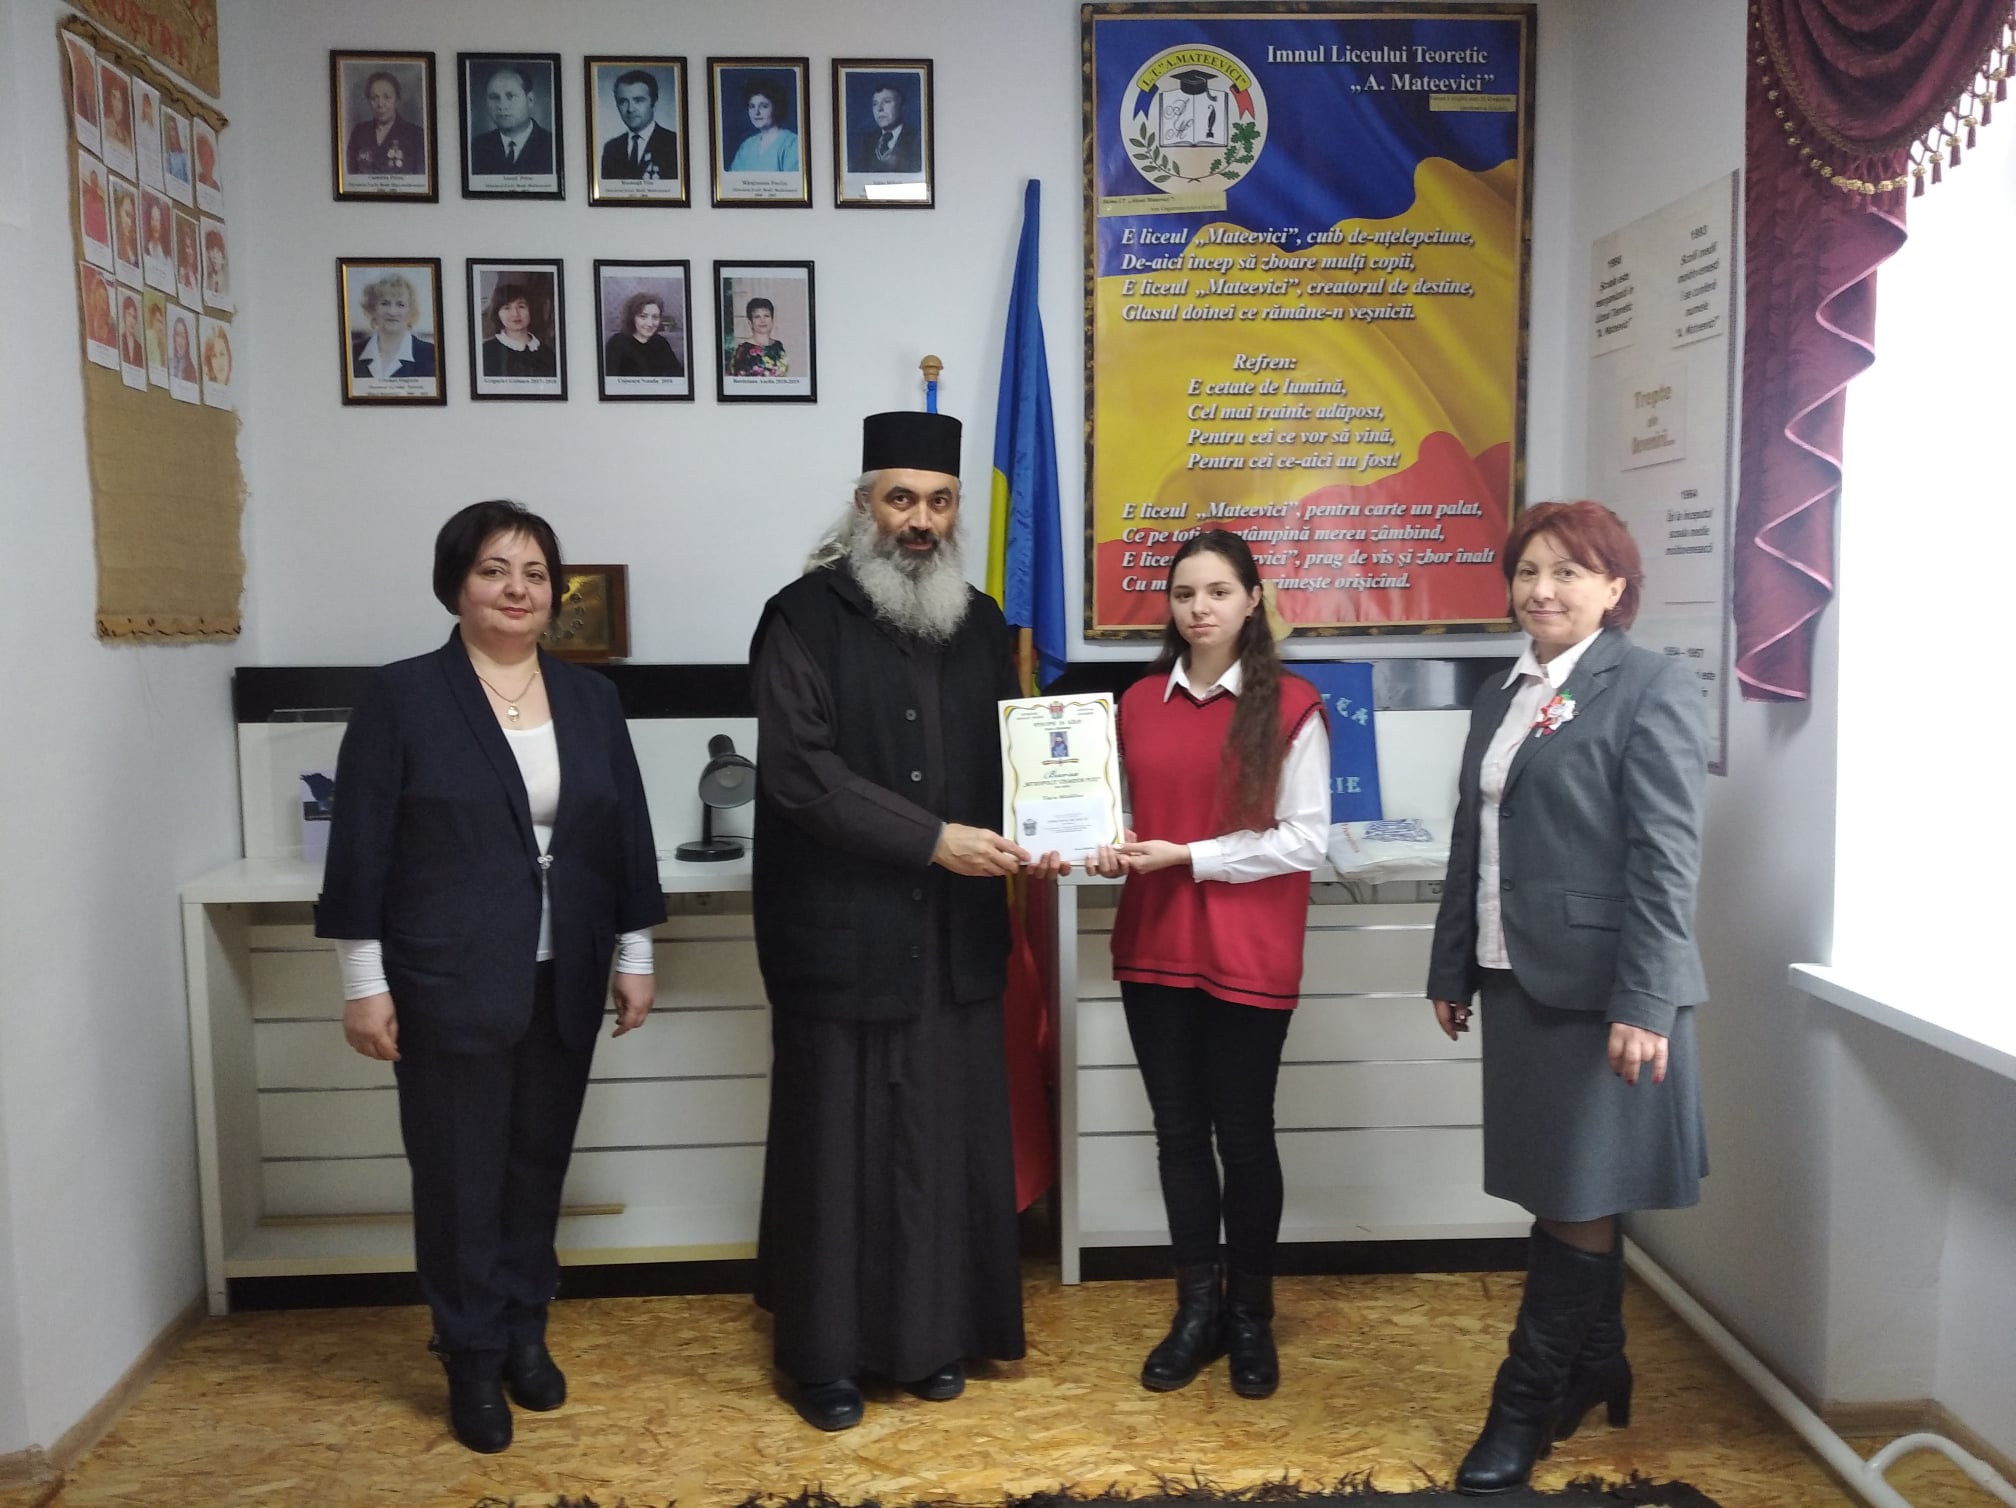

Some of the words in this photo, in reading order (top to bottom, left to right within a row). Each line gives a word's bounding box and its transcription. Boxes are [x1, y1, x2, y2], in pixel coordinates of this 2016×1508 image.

[1267, 46, 1325, 63] Imnul
[1331, 46, 1407, 63] Liceului
[1412, 46, 1488, 63] Teoretic
[1391, 73, 1494, 91] Mateevici”
[1121, 229, 1136, 244] E
[1140, 228, 1188, 244] liceul
[1306, 228, 1344, 244] cuib
[1121, 254, 1184, 270] De-aici
[1188, 254, 1233, 273] încep
[1238, 254, 1257, 270] să
[1261, 254, 1316, 270] zboare
[1369, 253, 1415, 273] copii,
[1122, 280, 1136, 295] E
[1140, 279, 1188, 295] liceul
[1307, 278, 1386, 295] creatorul
[1388, 278, 1409, 294] de
[1412, 279, 1475, 296] destine,
[1122, 304, 1179, 320] Glasul
[1182, 304, 1235, 320] doinei
[1239, 309, 1257, 320] ce
[1262, 304, 1345, 320] rămâne-n
[1233, 354, 1297, 373] Refren:
[1187, 379, 1202, 395] E
[1205, 380, 1255, 395] cetate
[1259, 379, 1279, 395] de
[1282, 378, 1348, 396] lumină,
[1188, 403, 1217, 419] Cel
[1220, 404, 1253, 419] mai
[1256, 404, 1312, 419] trainic
[1316, 403, 1385, 423] adăpost,
[1187, 429, 1245, 444] Pentru
[1249, 429, 1274, 443] cei
[1277, 432, 1296, 443] ce
[1301, 432, 1328, 443] vor
[1331, 428, 1349, 443] să
[1354, 428, 1395, 445] vină,
[1187, 453, 1244, 469] Pentru
[1249, 453, 1274, 468] cei
[1277, 453, 1334, 468] ce-aici
[1335, 457, 1359, 468] au
[1359, 452, 1400, 470] fost!
[1122, 503, 1136, 519] E
[1140, 503, 1188, 519] liceul
[1304, 503, 1361, 521] pentru
[1364, 503, 1407, 516] carte
[1411, 504, 1433, 516] un
[1435, 500, 1484, 519] palat,
[1122, 527, 1145, 543] Ce
[1147, 531, 1168, 546] pe
[1314, 528, 1367, 541] mereu
[1370, 524, 1445, 542] zâmbind,
[1122, 552, 1136, 567] E
[1303, 551, 1345, 569] prag
[1347, 549, 1368, 564] de
[1372, 549, 1394, 564] vis
[1397, 549, 1415, 568] și
[1416, 548, 1453, 565] zbor
[1455, 547, 1496, 564] înalt
[1122, 576, 1149, 591] Cu
